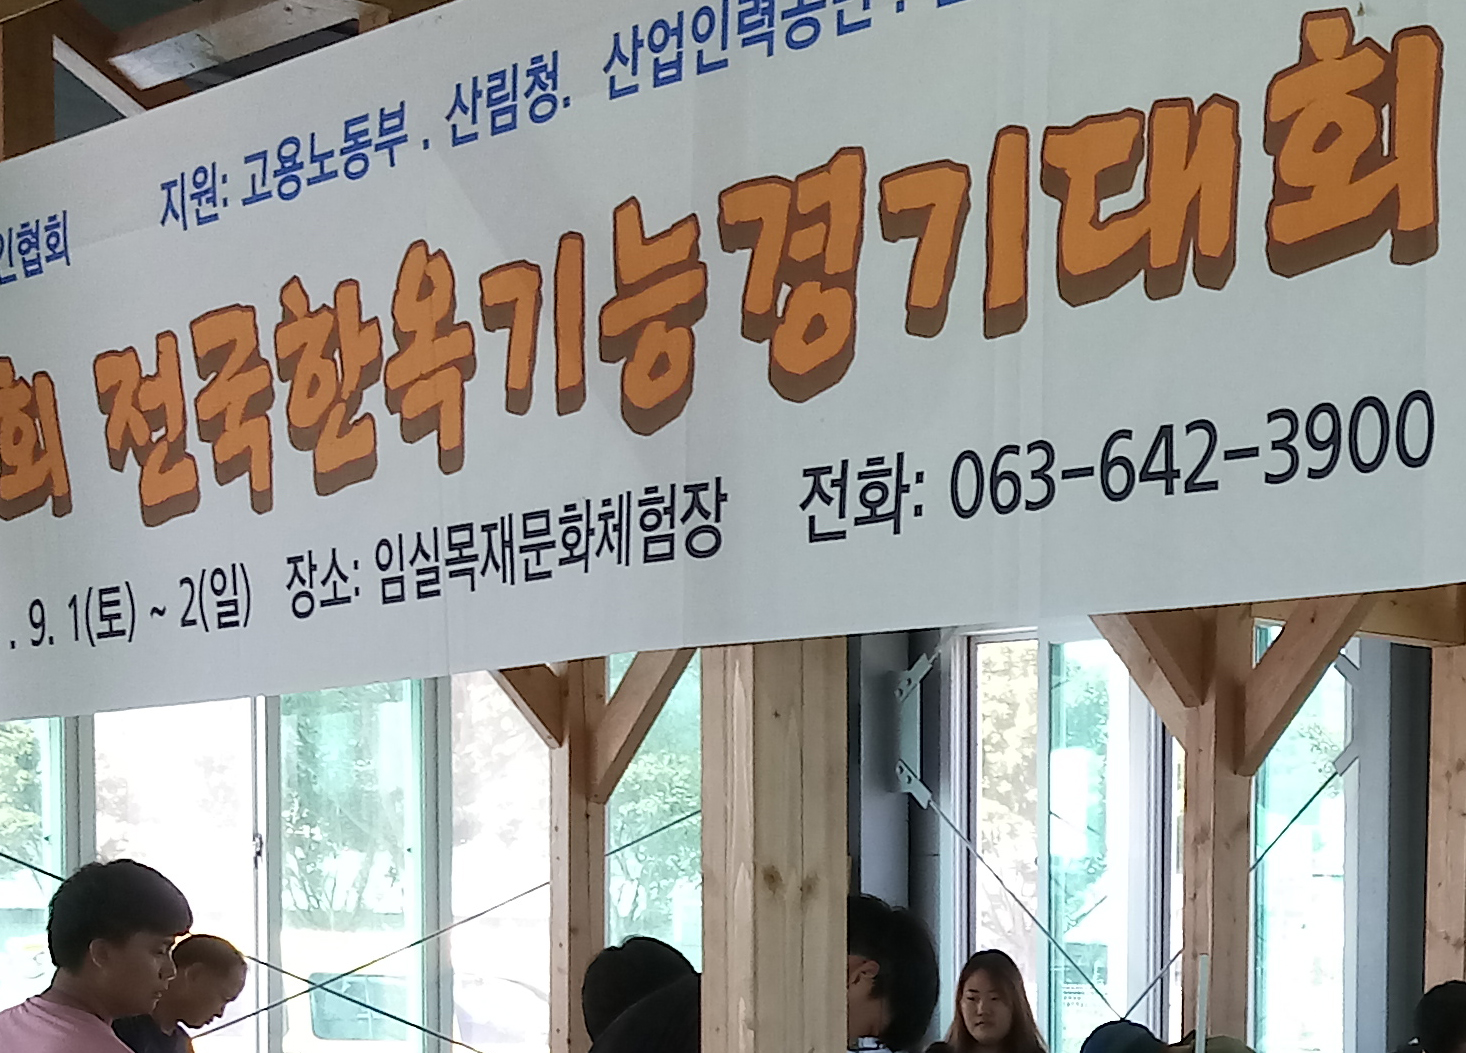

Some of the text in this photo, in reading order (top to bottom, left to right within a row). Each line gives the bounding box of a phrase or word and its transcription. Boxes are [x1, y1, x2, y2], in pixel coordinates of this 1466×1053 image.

[159, 161, 228, 231] 지원:
[242, 100, 408, 206] 고용노동부
[445, 50, 571, 147] 산림청.
[0, 356, 73, 521] 회
[180, 563, 251, 633] 2(일)
[285, 547, 361, 619] 장소:
[375, 476, 728, 605] 임실목재문화체험장
[799, 451, 925, 544] 전화:
[949, 389, 1435, 520] 063-642-3900
